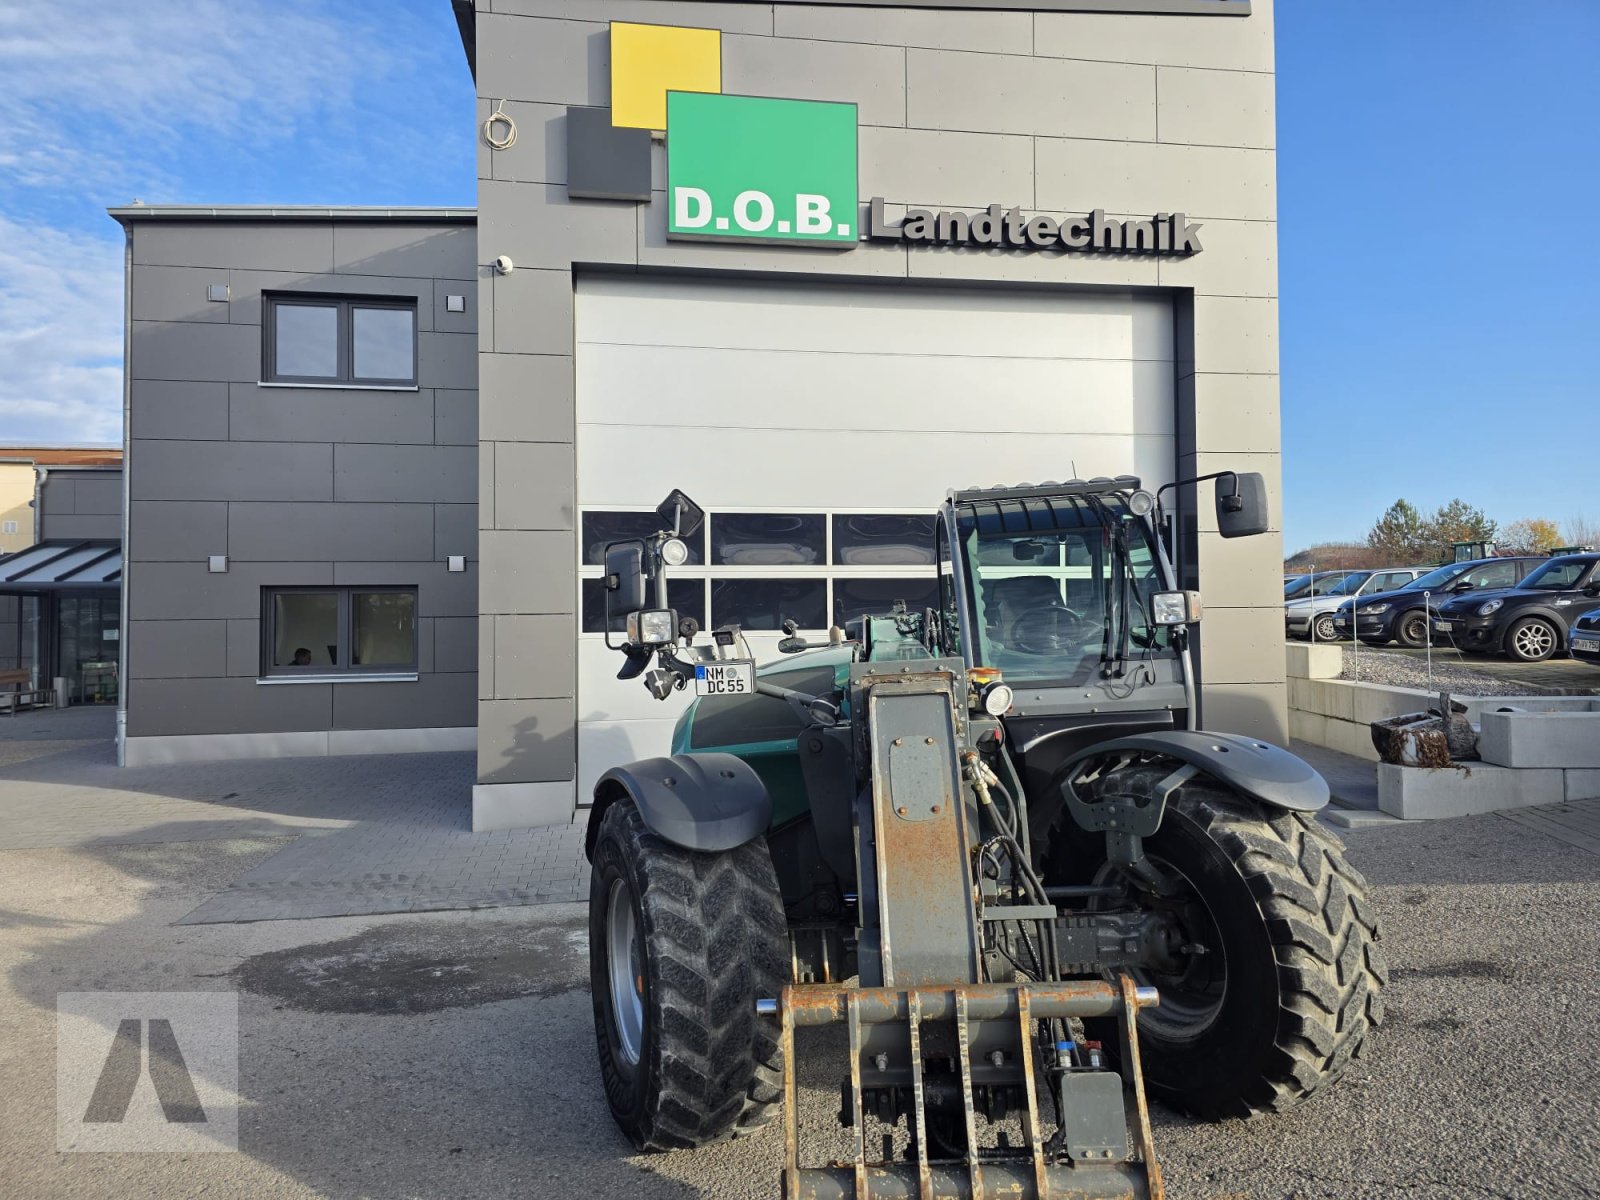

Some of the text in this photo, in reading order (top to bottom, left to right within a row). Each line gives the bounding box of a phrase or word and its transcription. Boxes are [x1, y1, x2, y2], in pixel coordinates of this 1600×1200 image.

[675, 186, 850, 236] D.O.B.
[870, 197, 1203, 252] Landtechnik
[706, 667, 724, 680] NM
[707, 680, 744, 693] DC 55
